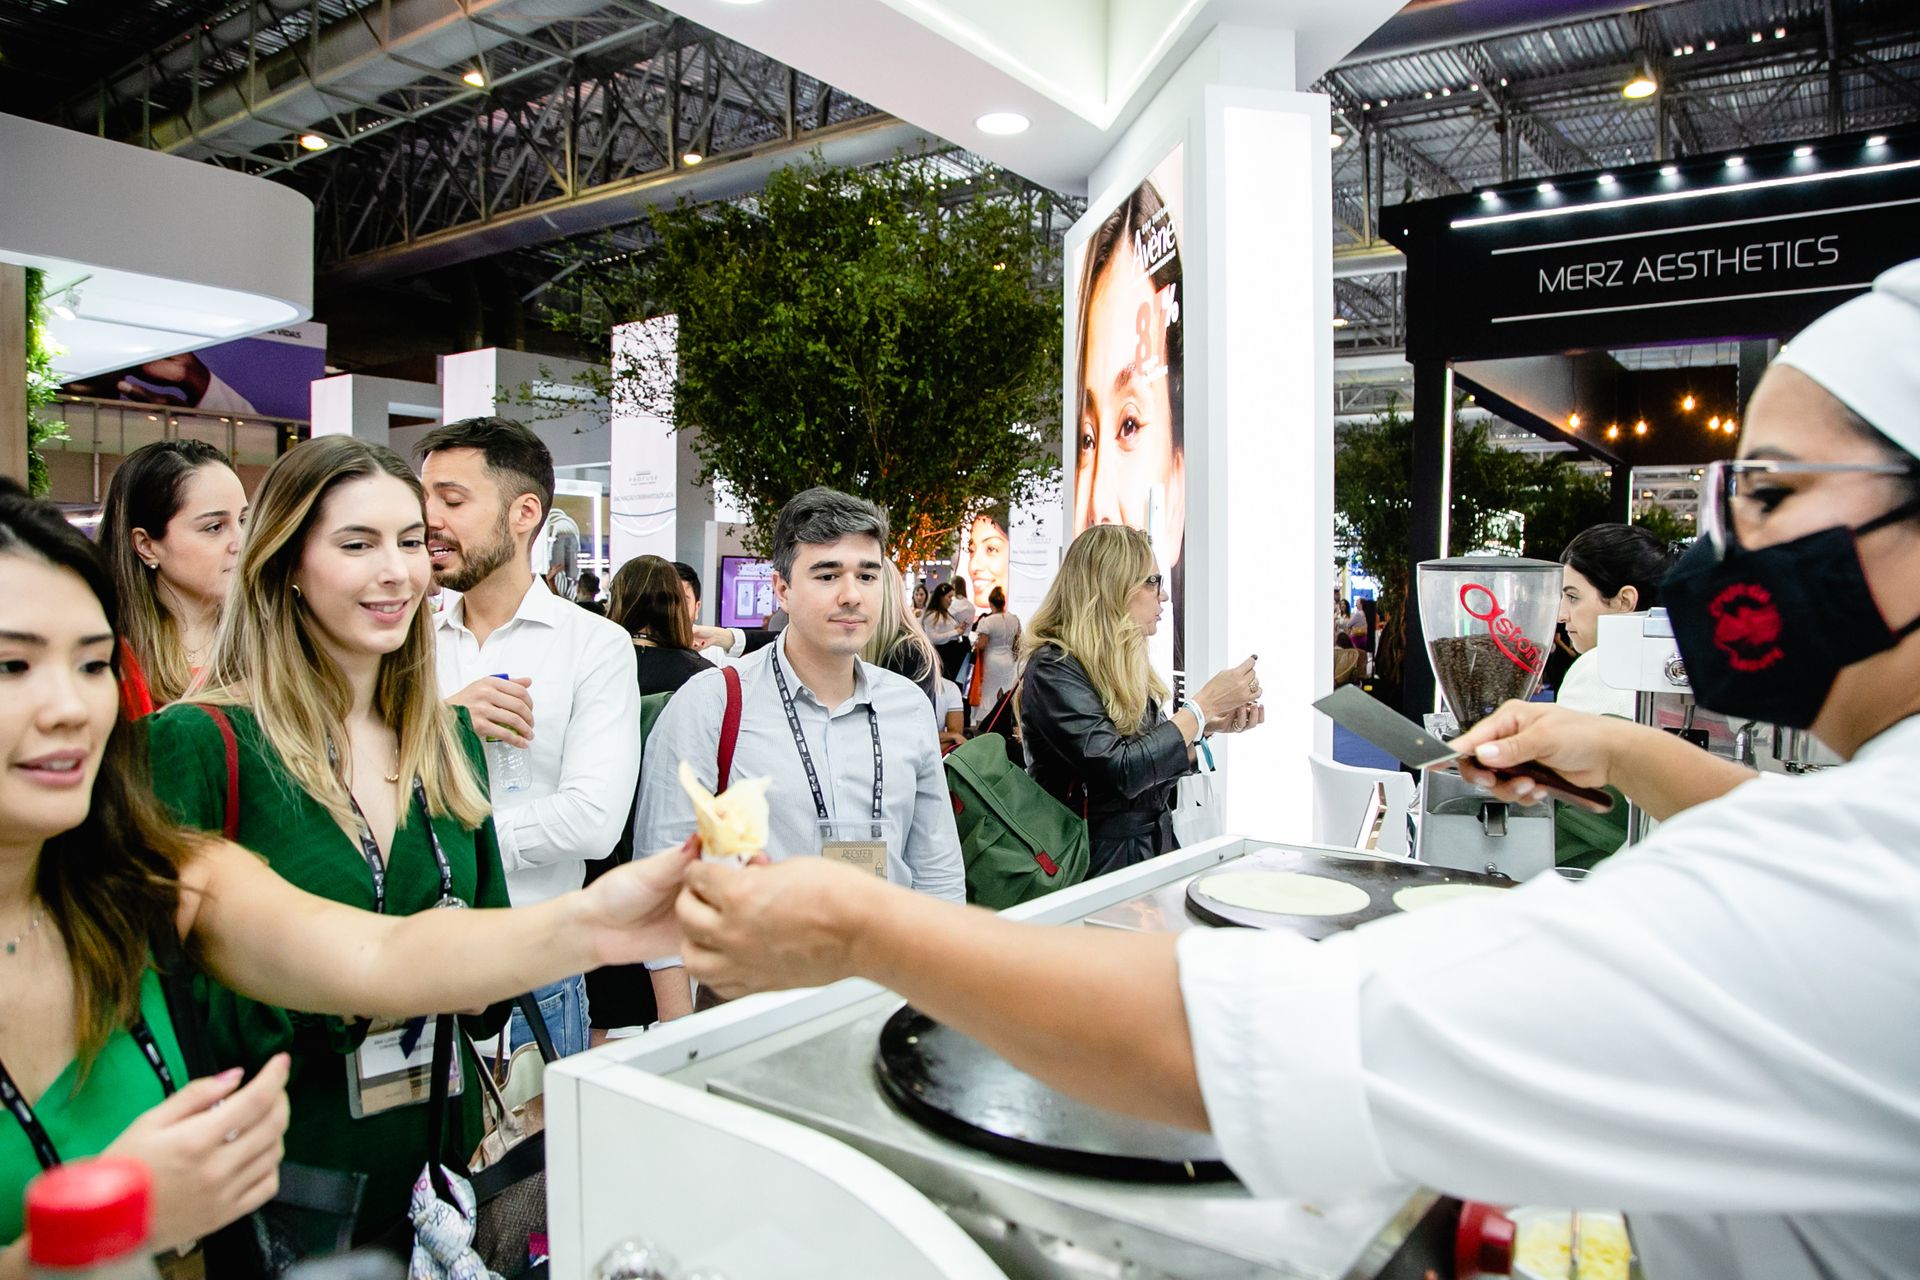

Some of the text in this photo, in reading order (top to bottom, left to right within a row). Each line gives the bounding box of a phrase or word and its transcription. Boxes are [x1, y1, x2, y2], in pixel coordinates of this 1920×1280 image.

[1132, 219, 1177, 272] Avène
[1539, 235, 1839, 294] MERZ AESTHETICS
